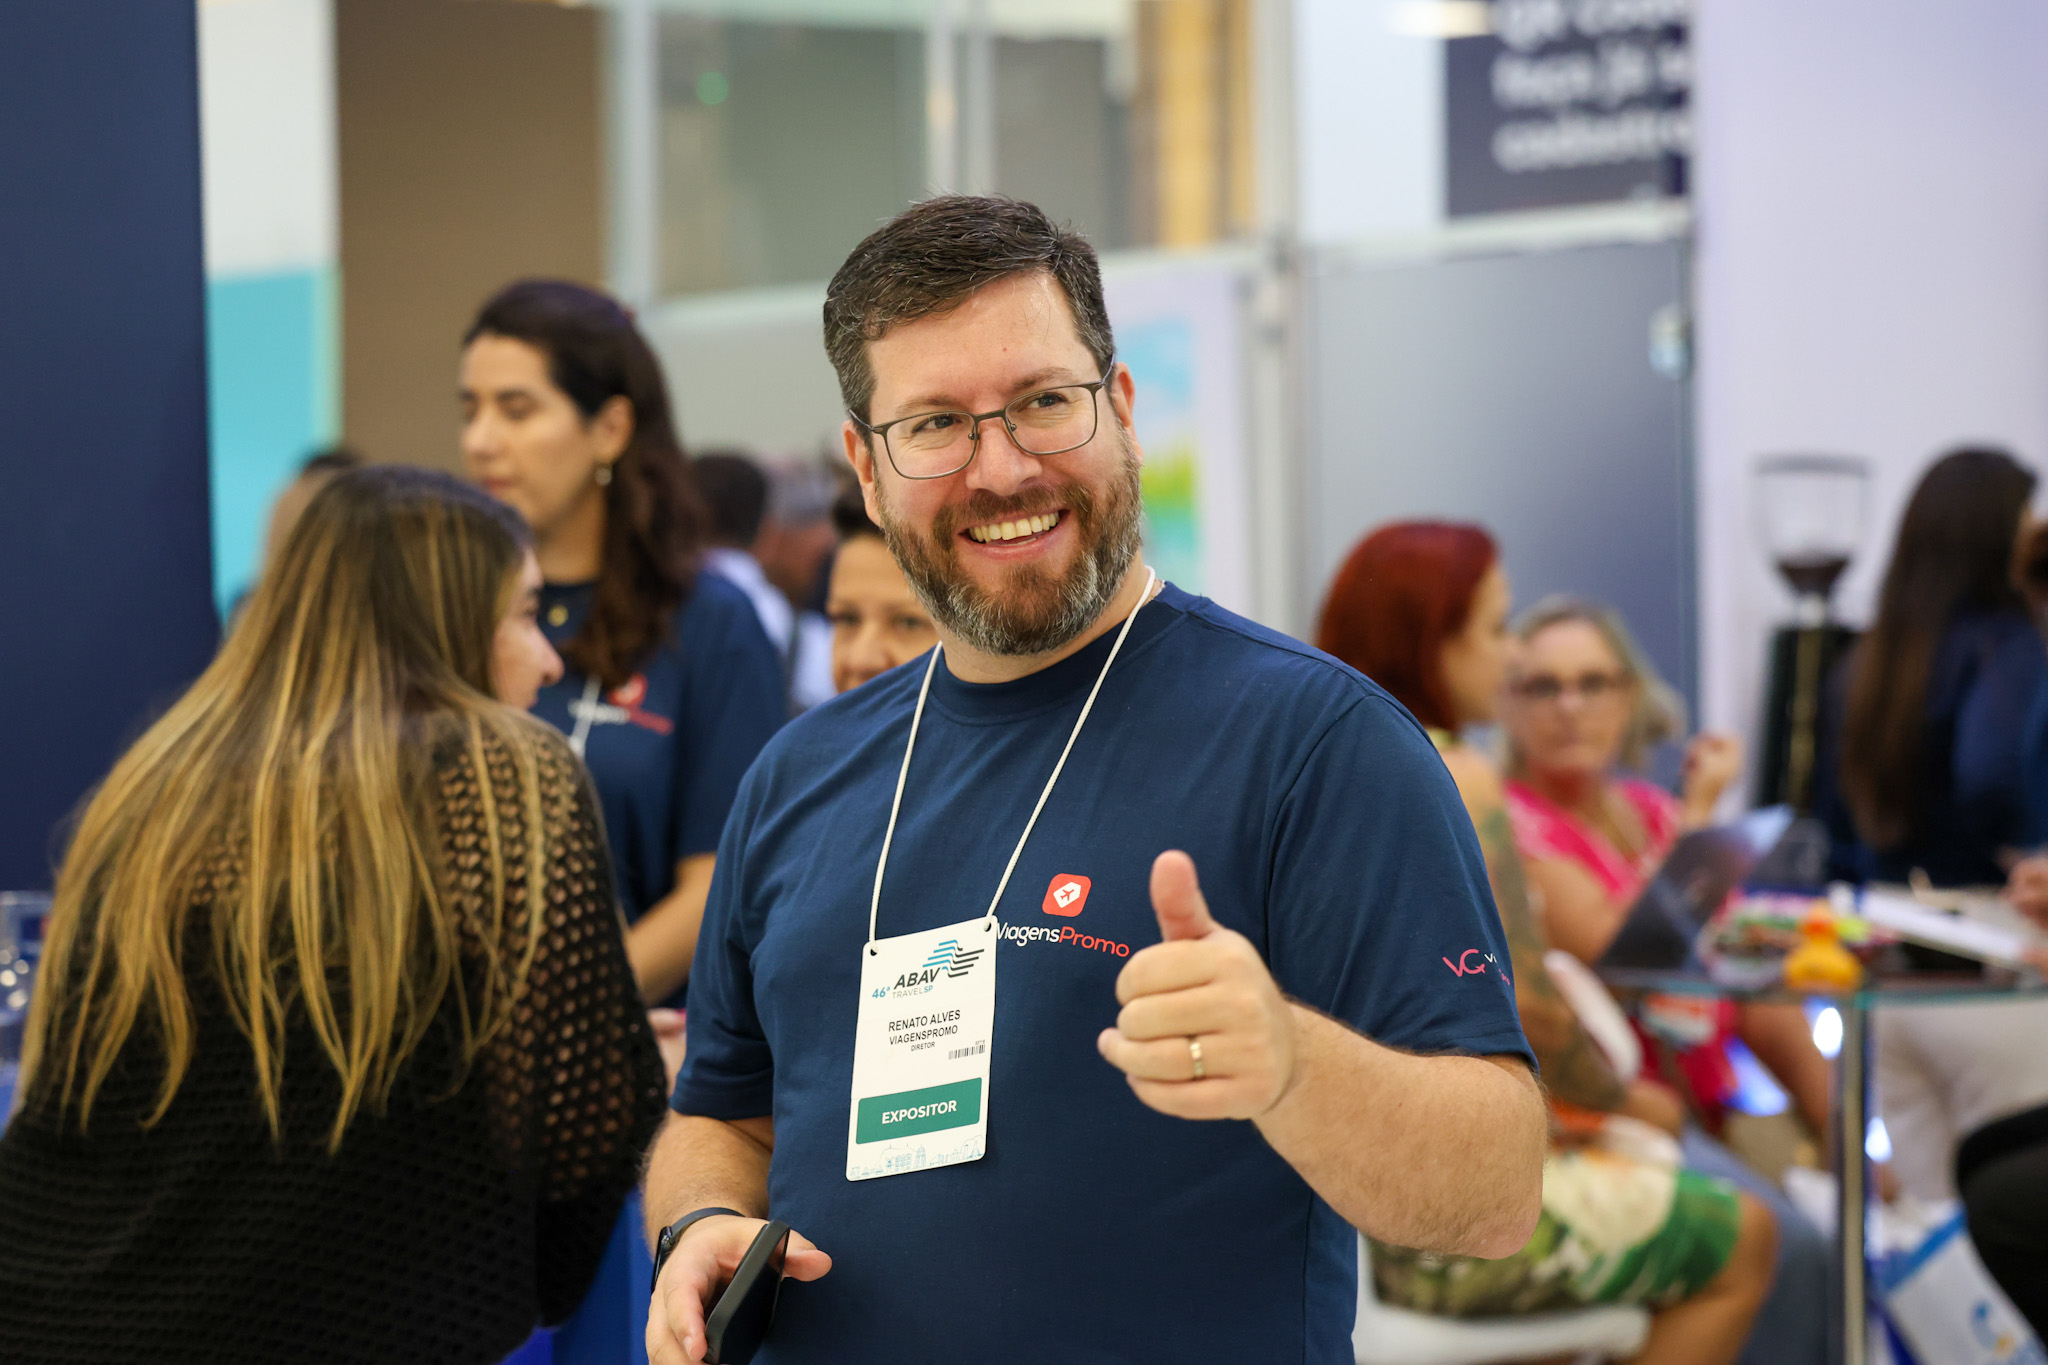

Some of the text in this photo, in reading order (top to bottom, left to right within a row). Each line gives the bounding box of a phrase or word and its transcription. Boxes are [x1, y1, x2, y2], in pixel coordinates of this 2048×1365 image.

[893, 967, 941, 990] ABAV
[888, 1009, 961, 1032] RENATO ALVES
[889, 1024, 958, 1045] VIAGENSPROMO
[910, 1041, 935, 1051] DIRETOR
[881, 1100, 957, 1125] EXPOSITOR
